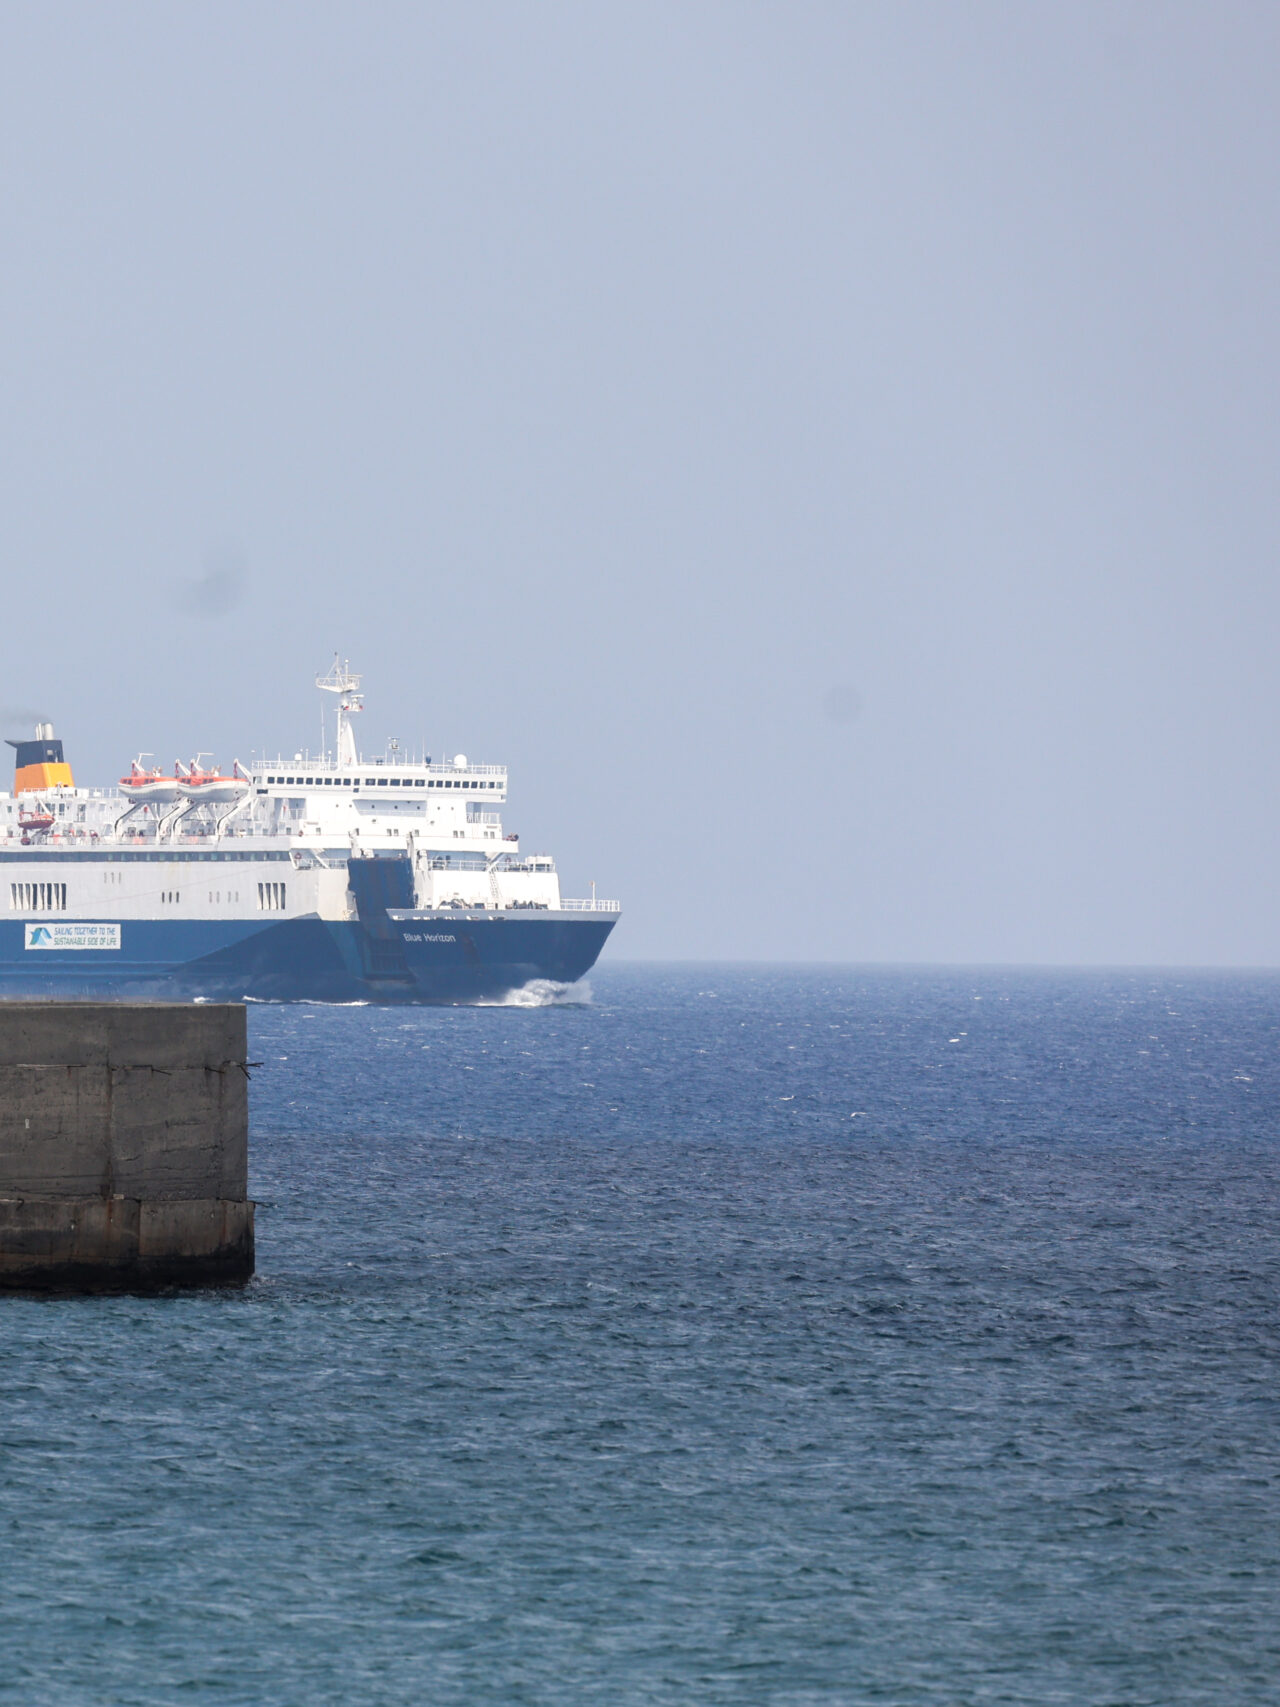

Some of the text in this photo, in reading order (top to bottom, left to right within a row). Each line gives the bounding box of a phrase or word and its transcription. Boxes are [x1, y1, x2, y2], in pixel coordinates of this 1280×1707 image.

[54, 927, 116, 936] SAILING TOGETHER TO THE
[53, 937, 117, 946] SUSTAINABLE SIDE OF LIFE
[403, 932, 457, 943] Blue Horizon
